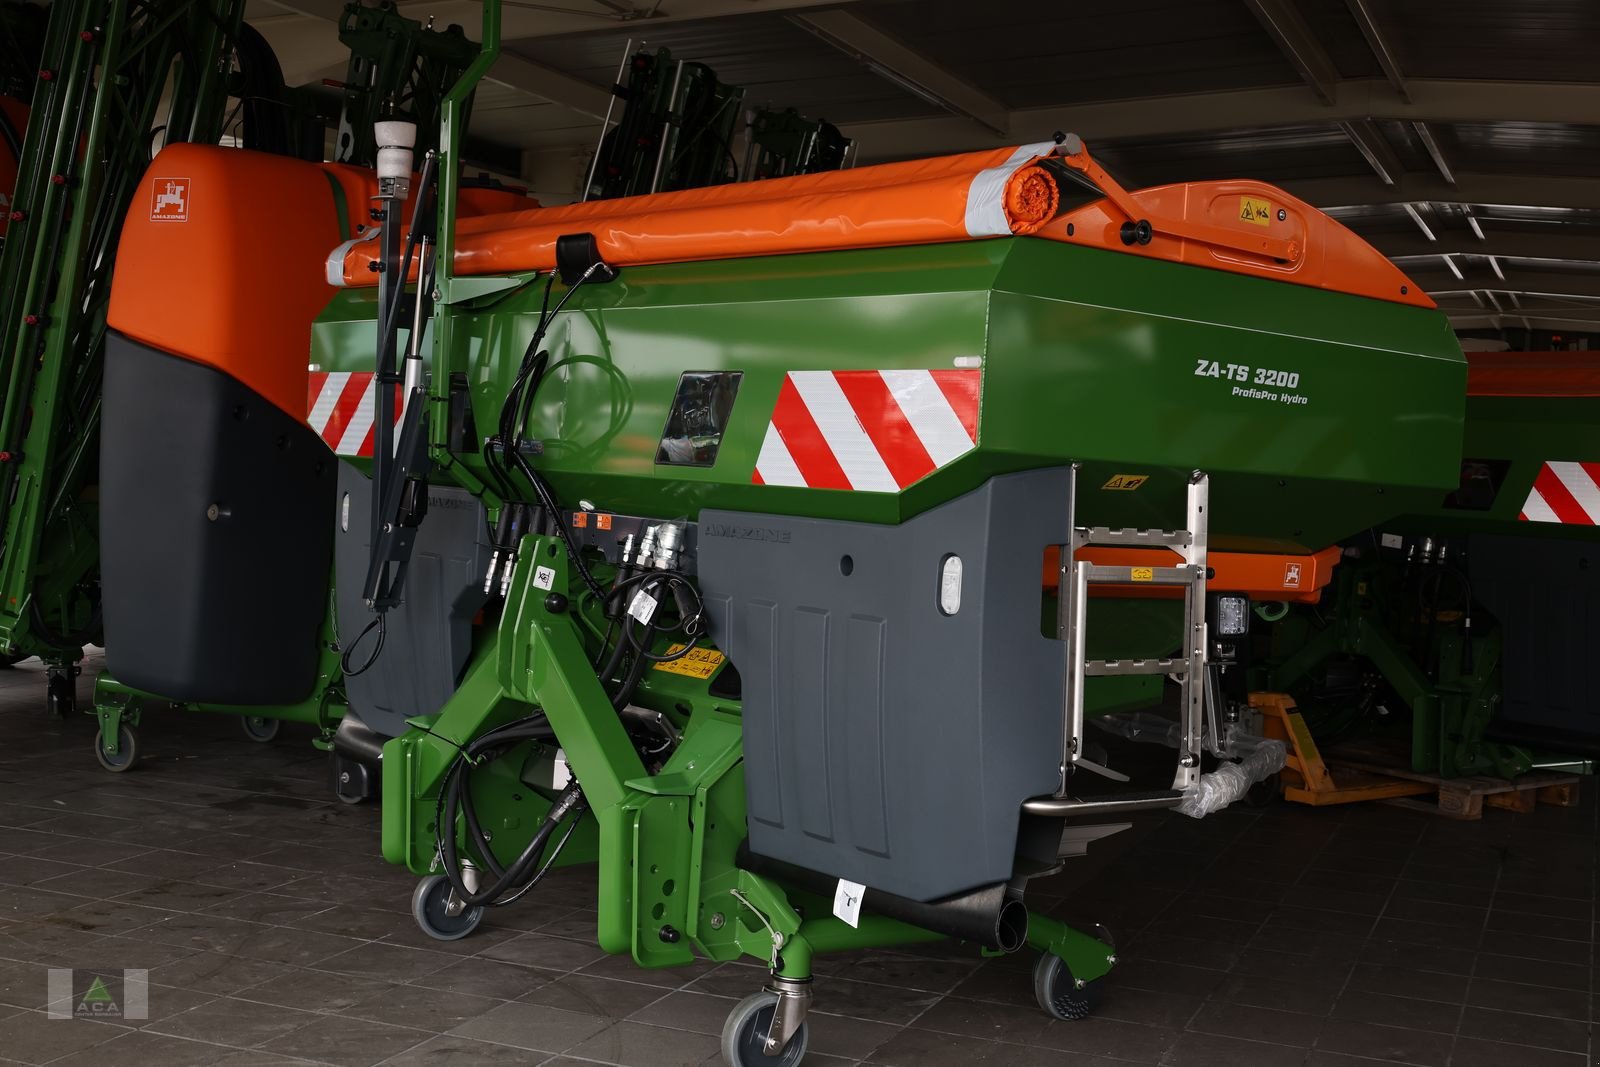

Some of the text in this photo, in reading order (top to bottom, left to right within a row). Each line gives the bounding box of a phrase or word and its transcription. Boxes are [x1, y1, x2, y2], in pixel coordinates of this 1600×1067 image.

[1194, 359, 1300, 389] ZA-TS 3200
[1231, 386, 1309, 405] ProfisPro Hydro
[704, 523, 792, 543] AMAZONE
